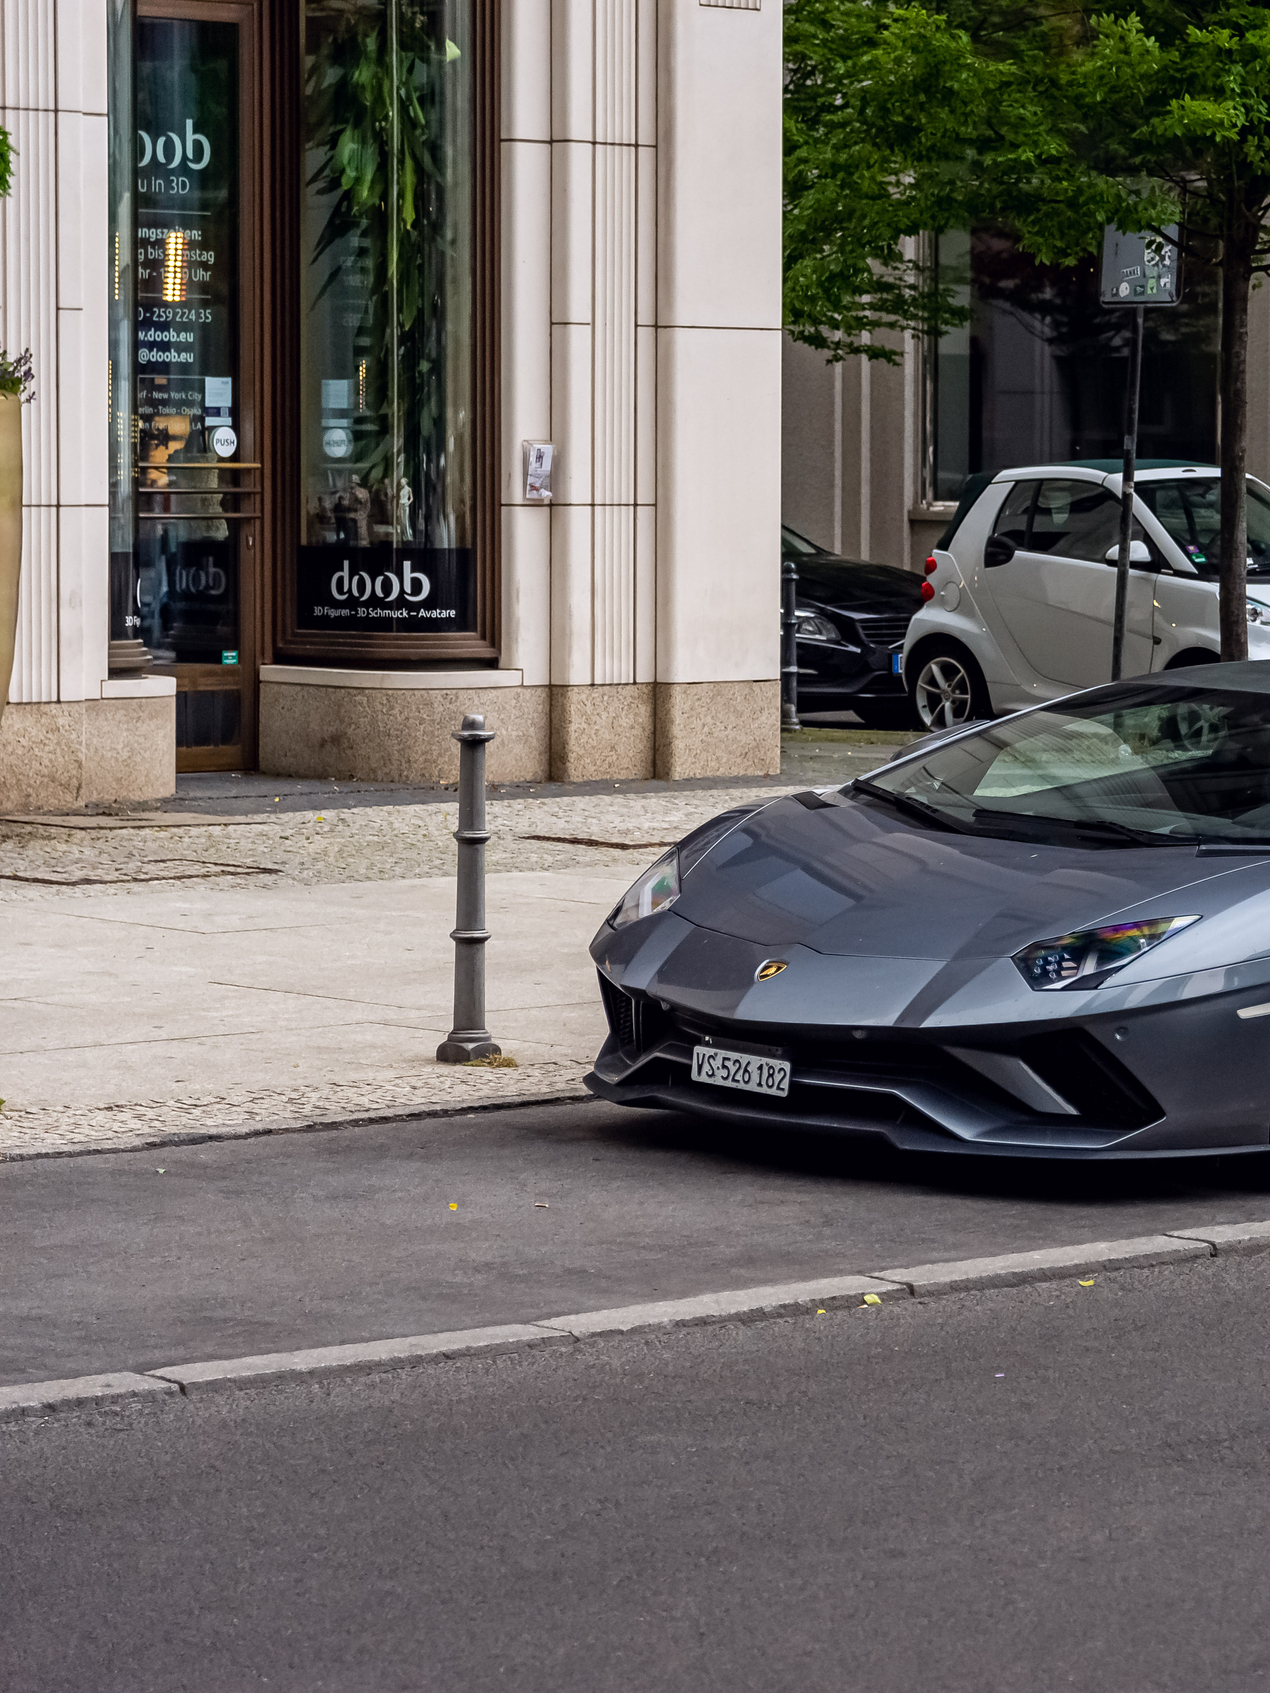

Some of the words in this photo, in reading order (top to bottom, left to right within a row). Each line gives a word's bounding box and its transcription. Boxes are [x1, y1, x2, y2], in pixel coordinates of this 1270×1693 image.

[151, 176, 164, 193] in
[169, 176, 189, 194] 3D
[148, 245, 164, 260] bis
[192, 267, 211, 281] Uhr
[153, 308, 172, 321] 259
[176, 309, 196, 322] 224
[199, 309, 212, 322] 35
[153, 391, 168, 400] New
[170, 391, 186, 400] York
[188, 391, 202, 402] City
[158, 406, 176, 415] Tokio
[192, 422, 201, 430] LA
[215, 438, 235, 447] PUSH
[330, 559, 431, 602] doob
[313, 606, 323, 616] 3D
[324, 606, 349, 618] Figuren
[357, 607, 367, 617] 3D
[368, 607, 408, 618] Schmuck
[418, 608, 456, 618] Avatare
